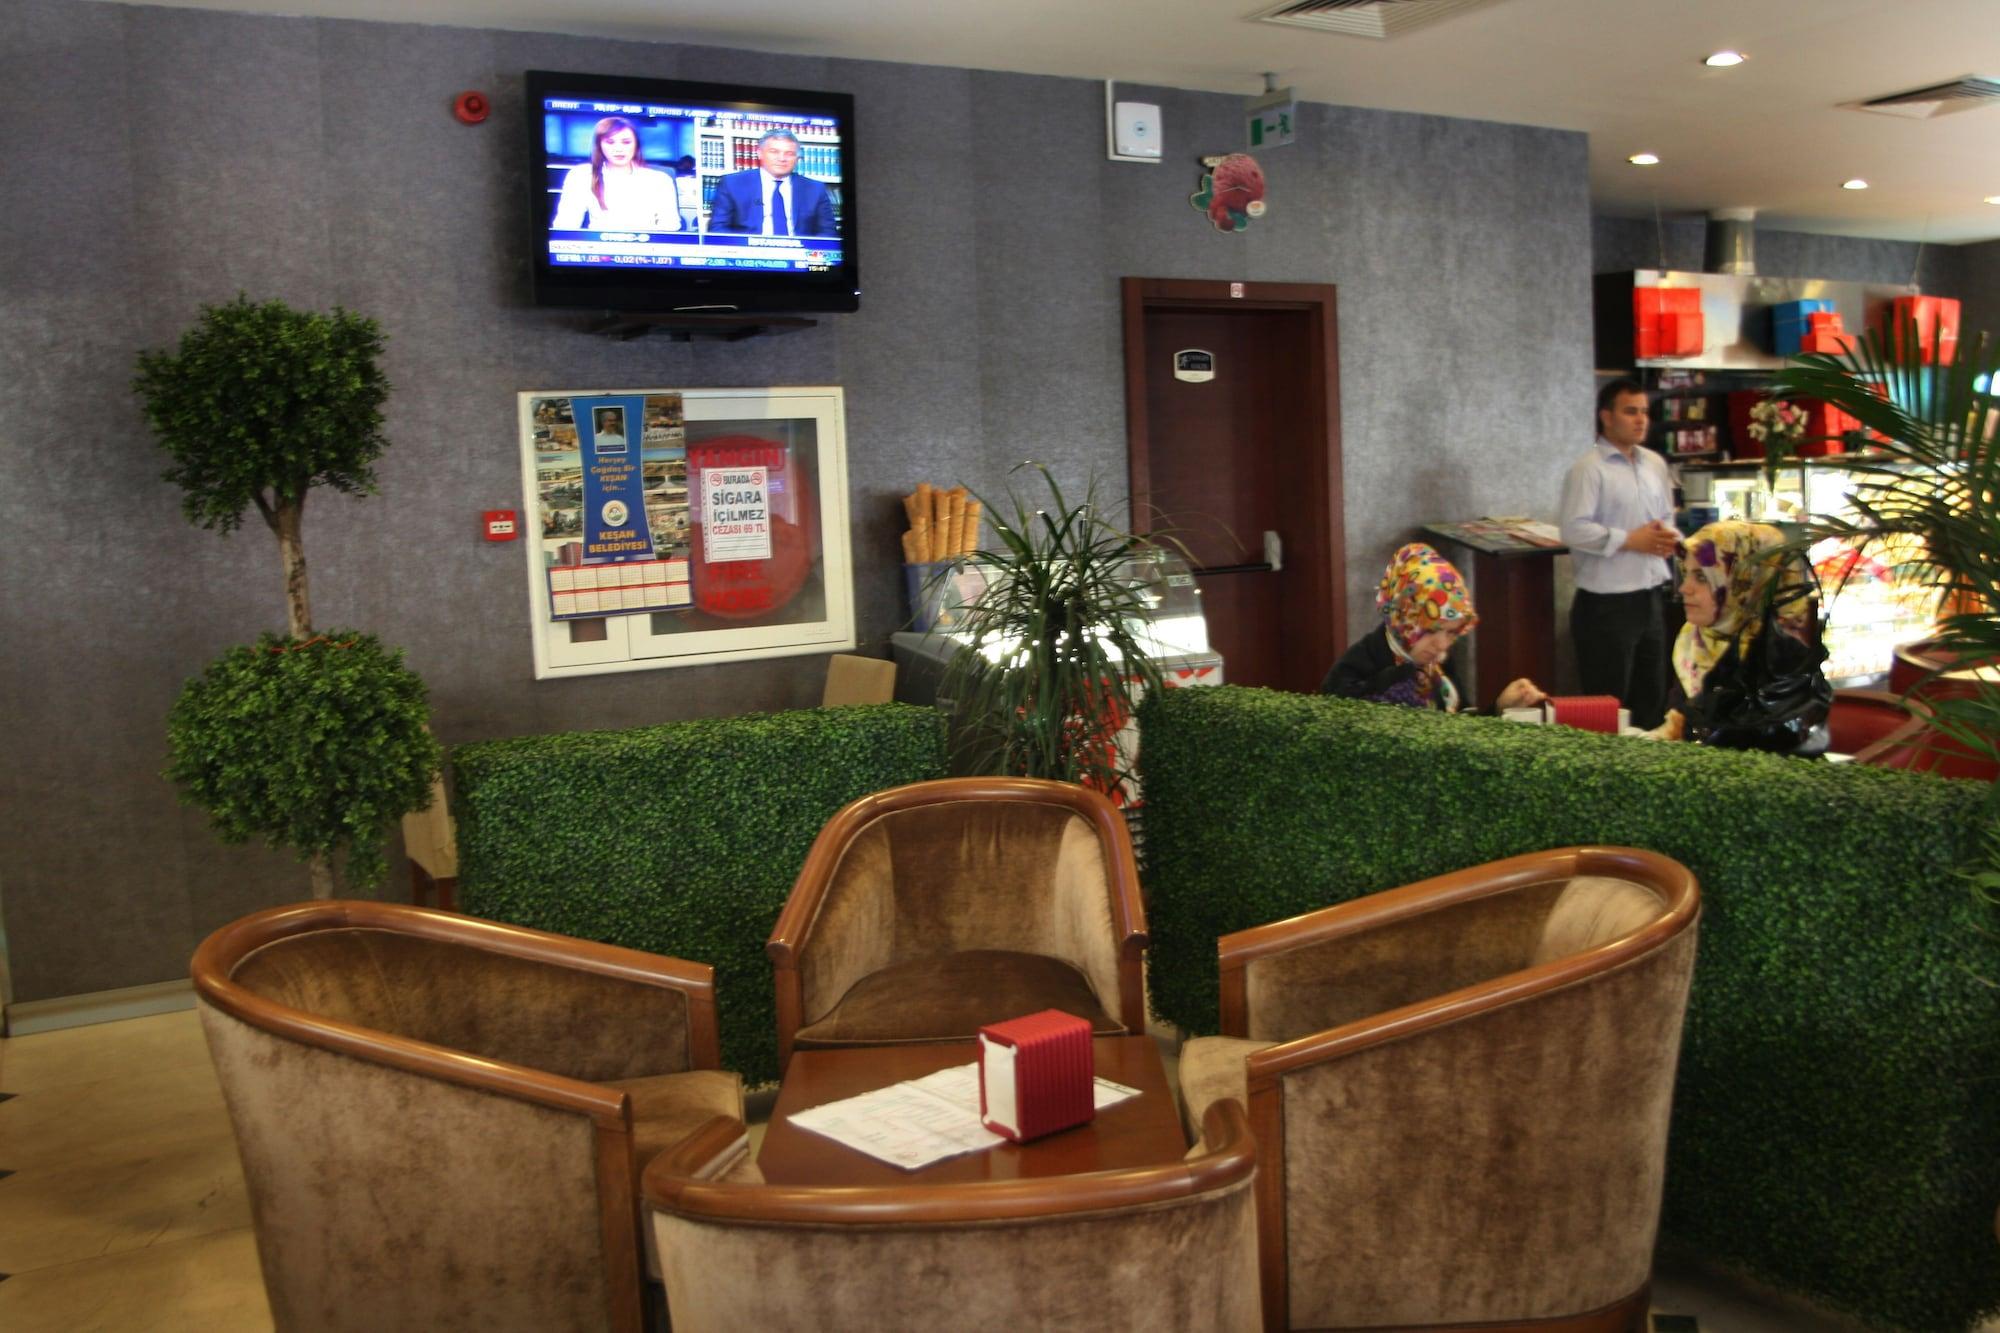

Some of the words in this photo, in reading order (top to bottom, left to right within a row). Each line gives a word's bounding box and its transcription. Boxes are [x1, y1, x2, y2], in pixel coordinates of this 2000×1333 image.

[722, 474, 751, 485] BURADA
[711, 490, 762, 506] SİGARA
[713, 509, 765, 525] İÇİLMEZ
[712, 525, 742, 535] CEZASI
[755, 523, 766, 533] TL
[599, 530, 636, 541] KEŞAN
[588, 540, 648, 553] BELEDİYESİ
